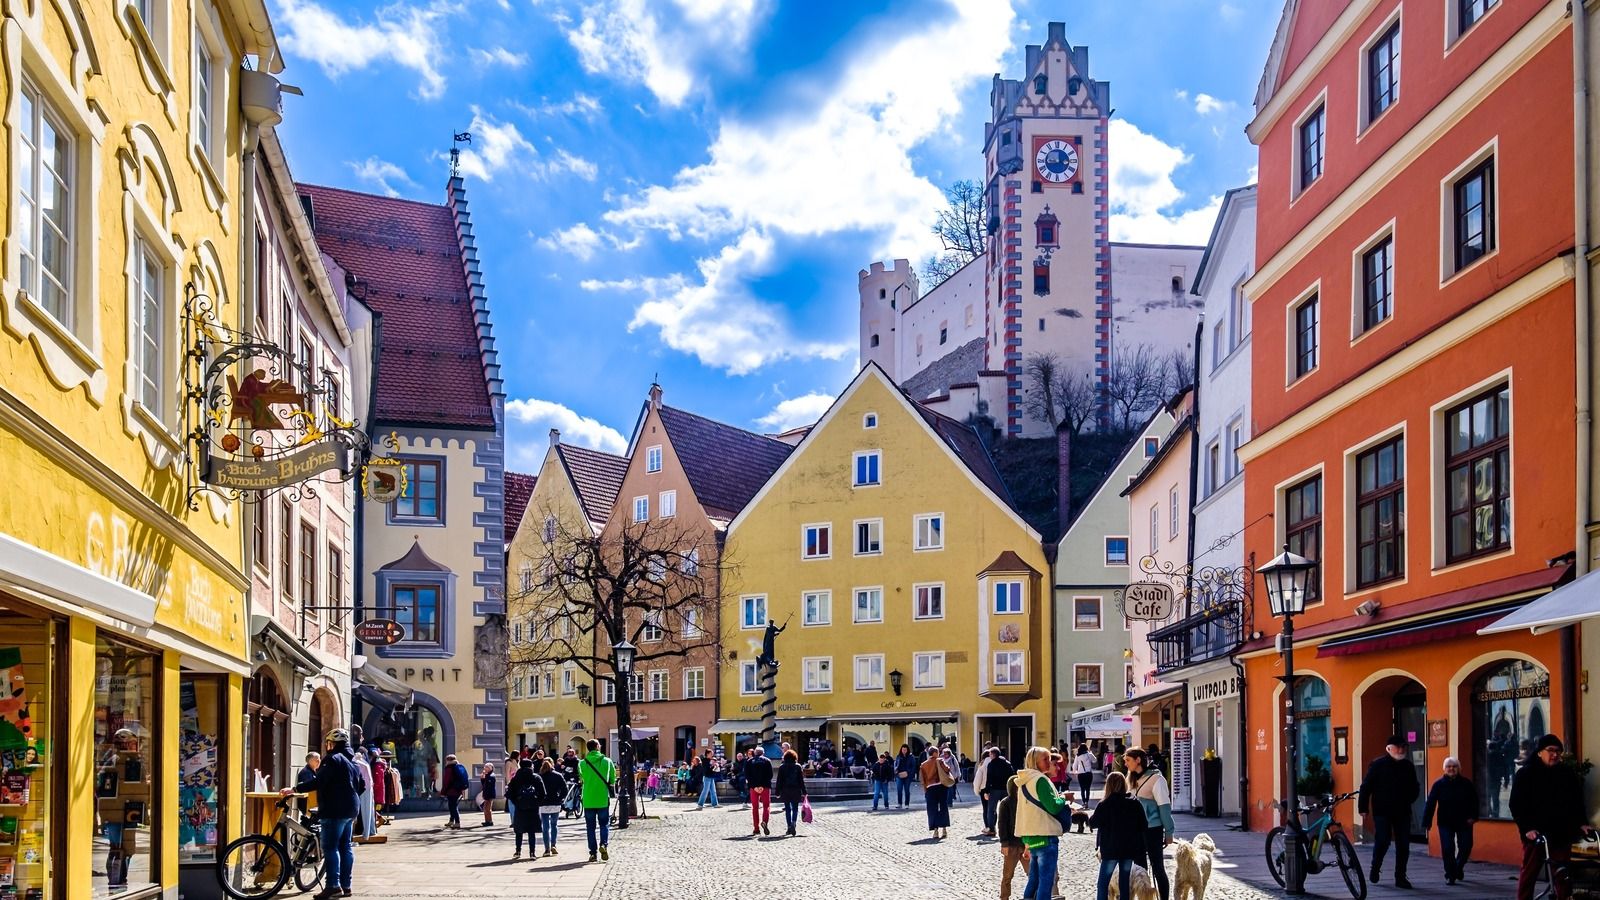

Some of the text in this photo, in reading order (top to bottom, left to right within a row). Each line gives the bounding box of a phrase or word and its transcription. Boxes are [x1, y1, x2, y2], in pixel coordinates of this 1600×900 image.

[277, 451, 337, 480] Bruhns
[1127, 587, 1168, 601] Stadt
[386, 667, 462, 682] SPRIT
[1193, 676, 1240, 701] LUITPOLD BR
[1479, 686, 1549, 702] ESTAURANT STADT CAF
[741, 703, 812, 713] ALLGÄ KUHSTALL
